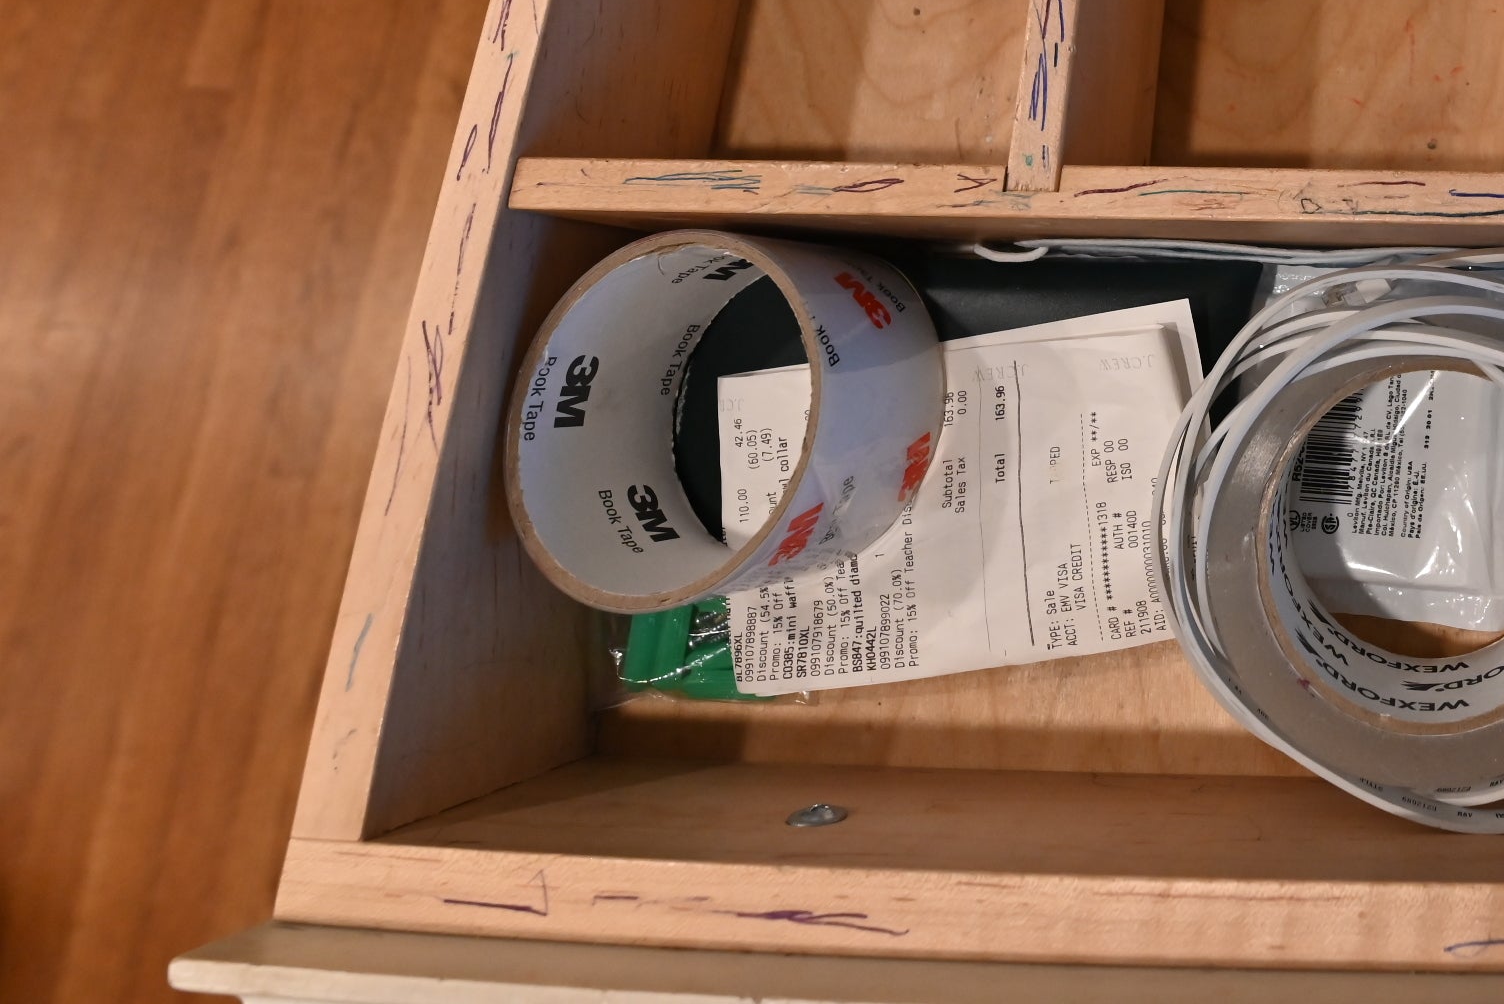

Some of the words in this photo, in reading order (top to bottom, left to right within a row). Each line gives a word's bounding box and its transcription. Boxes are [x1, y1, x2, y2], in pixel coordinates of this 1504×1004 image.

[702, 258, 754, 281] M
[833, 271, 892, 330] 3M
[673, 324, 700, 358] Book
[814, 323, 841, 368] Book
[532, 356, 557, 395] Book
[553, 354, 599, 429] 3M
[660, 360, 682, 396] Tape
[943, 391, 954, 427] 163.96
[957, 390, 966, 414] 0.00
[994, 385, 1005, 420] 163.96
[523, 399, 546, 442] Tape
[733, 418, 743, 447] 42.46
[746, 429, 759, 469] (60.05)
[760, 428, 774, 461] (7.49)
[778, 437, 789, 471] collar
[1090, 448, 1101, 466] EXP
[1103, 440, 1114, 452] 00
[1118, 438, 1128, 451] 00
[956, 457, 965, 475] Tax
[994, 453, 1004, 482] Total
[1105, 459, 1117, 482] RESP
[1120, 462, 1132, 479] ISO
[942, 459, 953, 508] Subtotal
[954, 481, 966, 513] Sales
[598, 489, 620, 523] Book
[612, 519, 644, 555] Tape
[627, 484, 681, 543] 3M
[737, 488, 749, 522] 110.00
[768, 502, 824, 567] 3M
[1112, 524, 1123, 549] AUTH
[903, 531, 914, 573] Teacher
[1070, 544, 1082, 580] CREDIT
[891, 569, 903, 610] (70.0%)
[904, 580, 915, 598] Off
[1058, 562, 1068, 588] VISA
[774, 592, 784, 610] Off
[824, 576, 837, 616] (50.0%)
[839, 587, 848, 604] Off
[906, 604, 916, 621] 15%
[1046, 590, 1056, 614] Sale
[1060, 595, 1072, 612] EMV
[1073, 586, 1085, 610] VISA
[772, 615, 782, 633] 15%
[840, 609, 850, 627] 15%
[852, 590, 863, 671] BS847:quilted
[879, 594, 890, 669] 099107899022
[1064, 618, 1077, 645] ACCT:
[1108, 616, 1121, 639] CARD
[1123, 621, 1136, 637] REF
[1137, 600, 1151, 634] 211908
[1154, 609, 1166, 630] AID:
[744, 607, 756, 681] 099107898887
[796, 626, 809, 677] SR7810XL
[810, 600, 823, 676] 099107918679
[824, 624, 836, 675] Discount
[894, 618, 904, 668] Discount
[908, 630, 918, 666] Promo:
[1049, 621, 1061, 648] TYPE:
[756, 631, 768, 681] Discount
[769, 643, 780, 680] Promo:
[837, 636, 848, 673] Promo:
[1337, 631, 1471, 674] WEXFORD
[1323, 660, 1470, 712] WEXFORD
